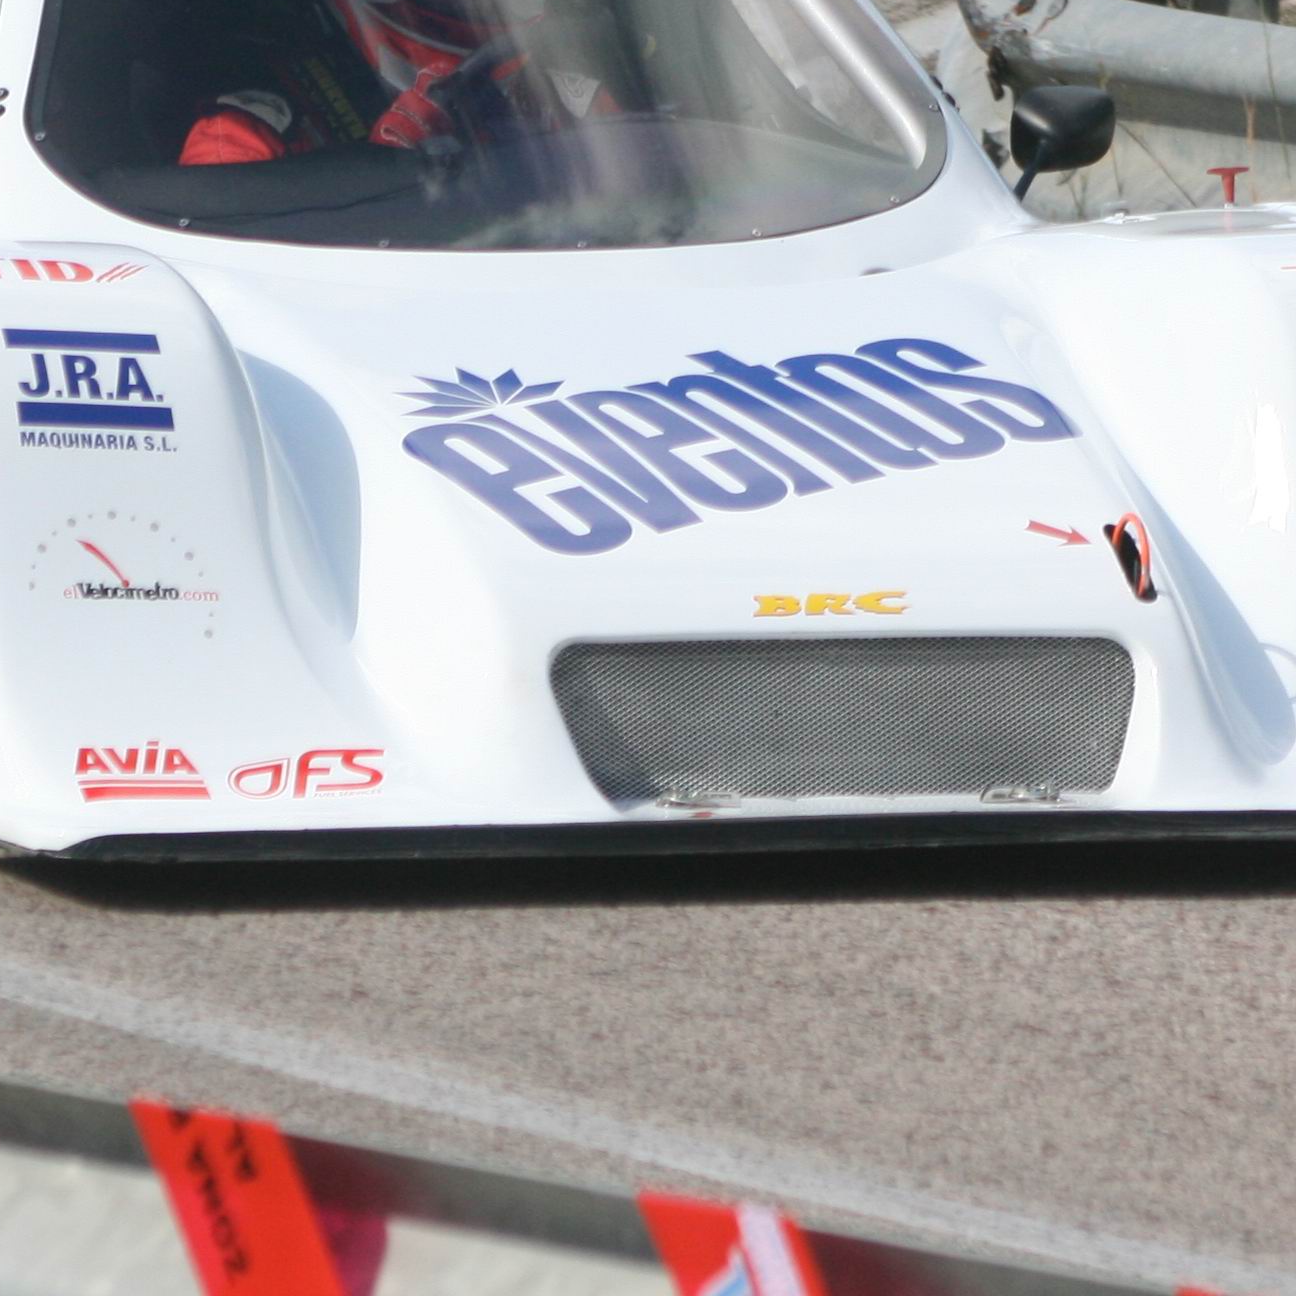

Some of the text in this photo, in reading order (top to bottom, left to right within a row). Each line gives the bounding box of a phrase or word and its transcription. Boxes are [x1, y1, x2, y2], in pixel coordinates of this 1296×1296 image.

[19, 353, 165, 403] J.R.A.
[20, 431, 178, 453] MAQUINARIA S.L.
[402, 337, 1083, 557] eventos
[753, 590, 909, 617] BRC
